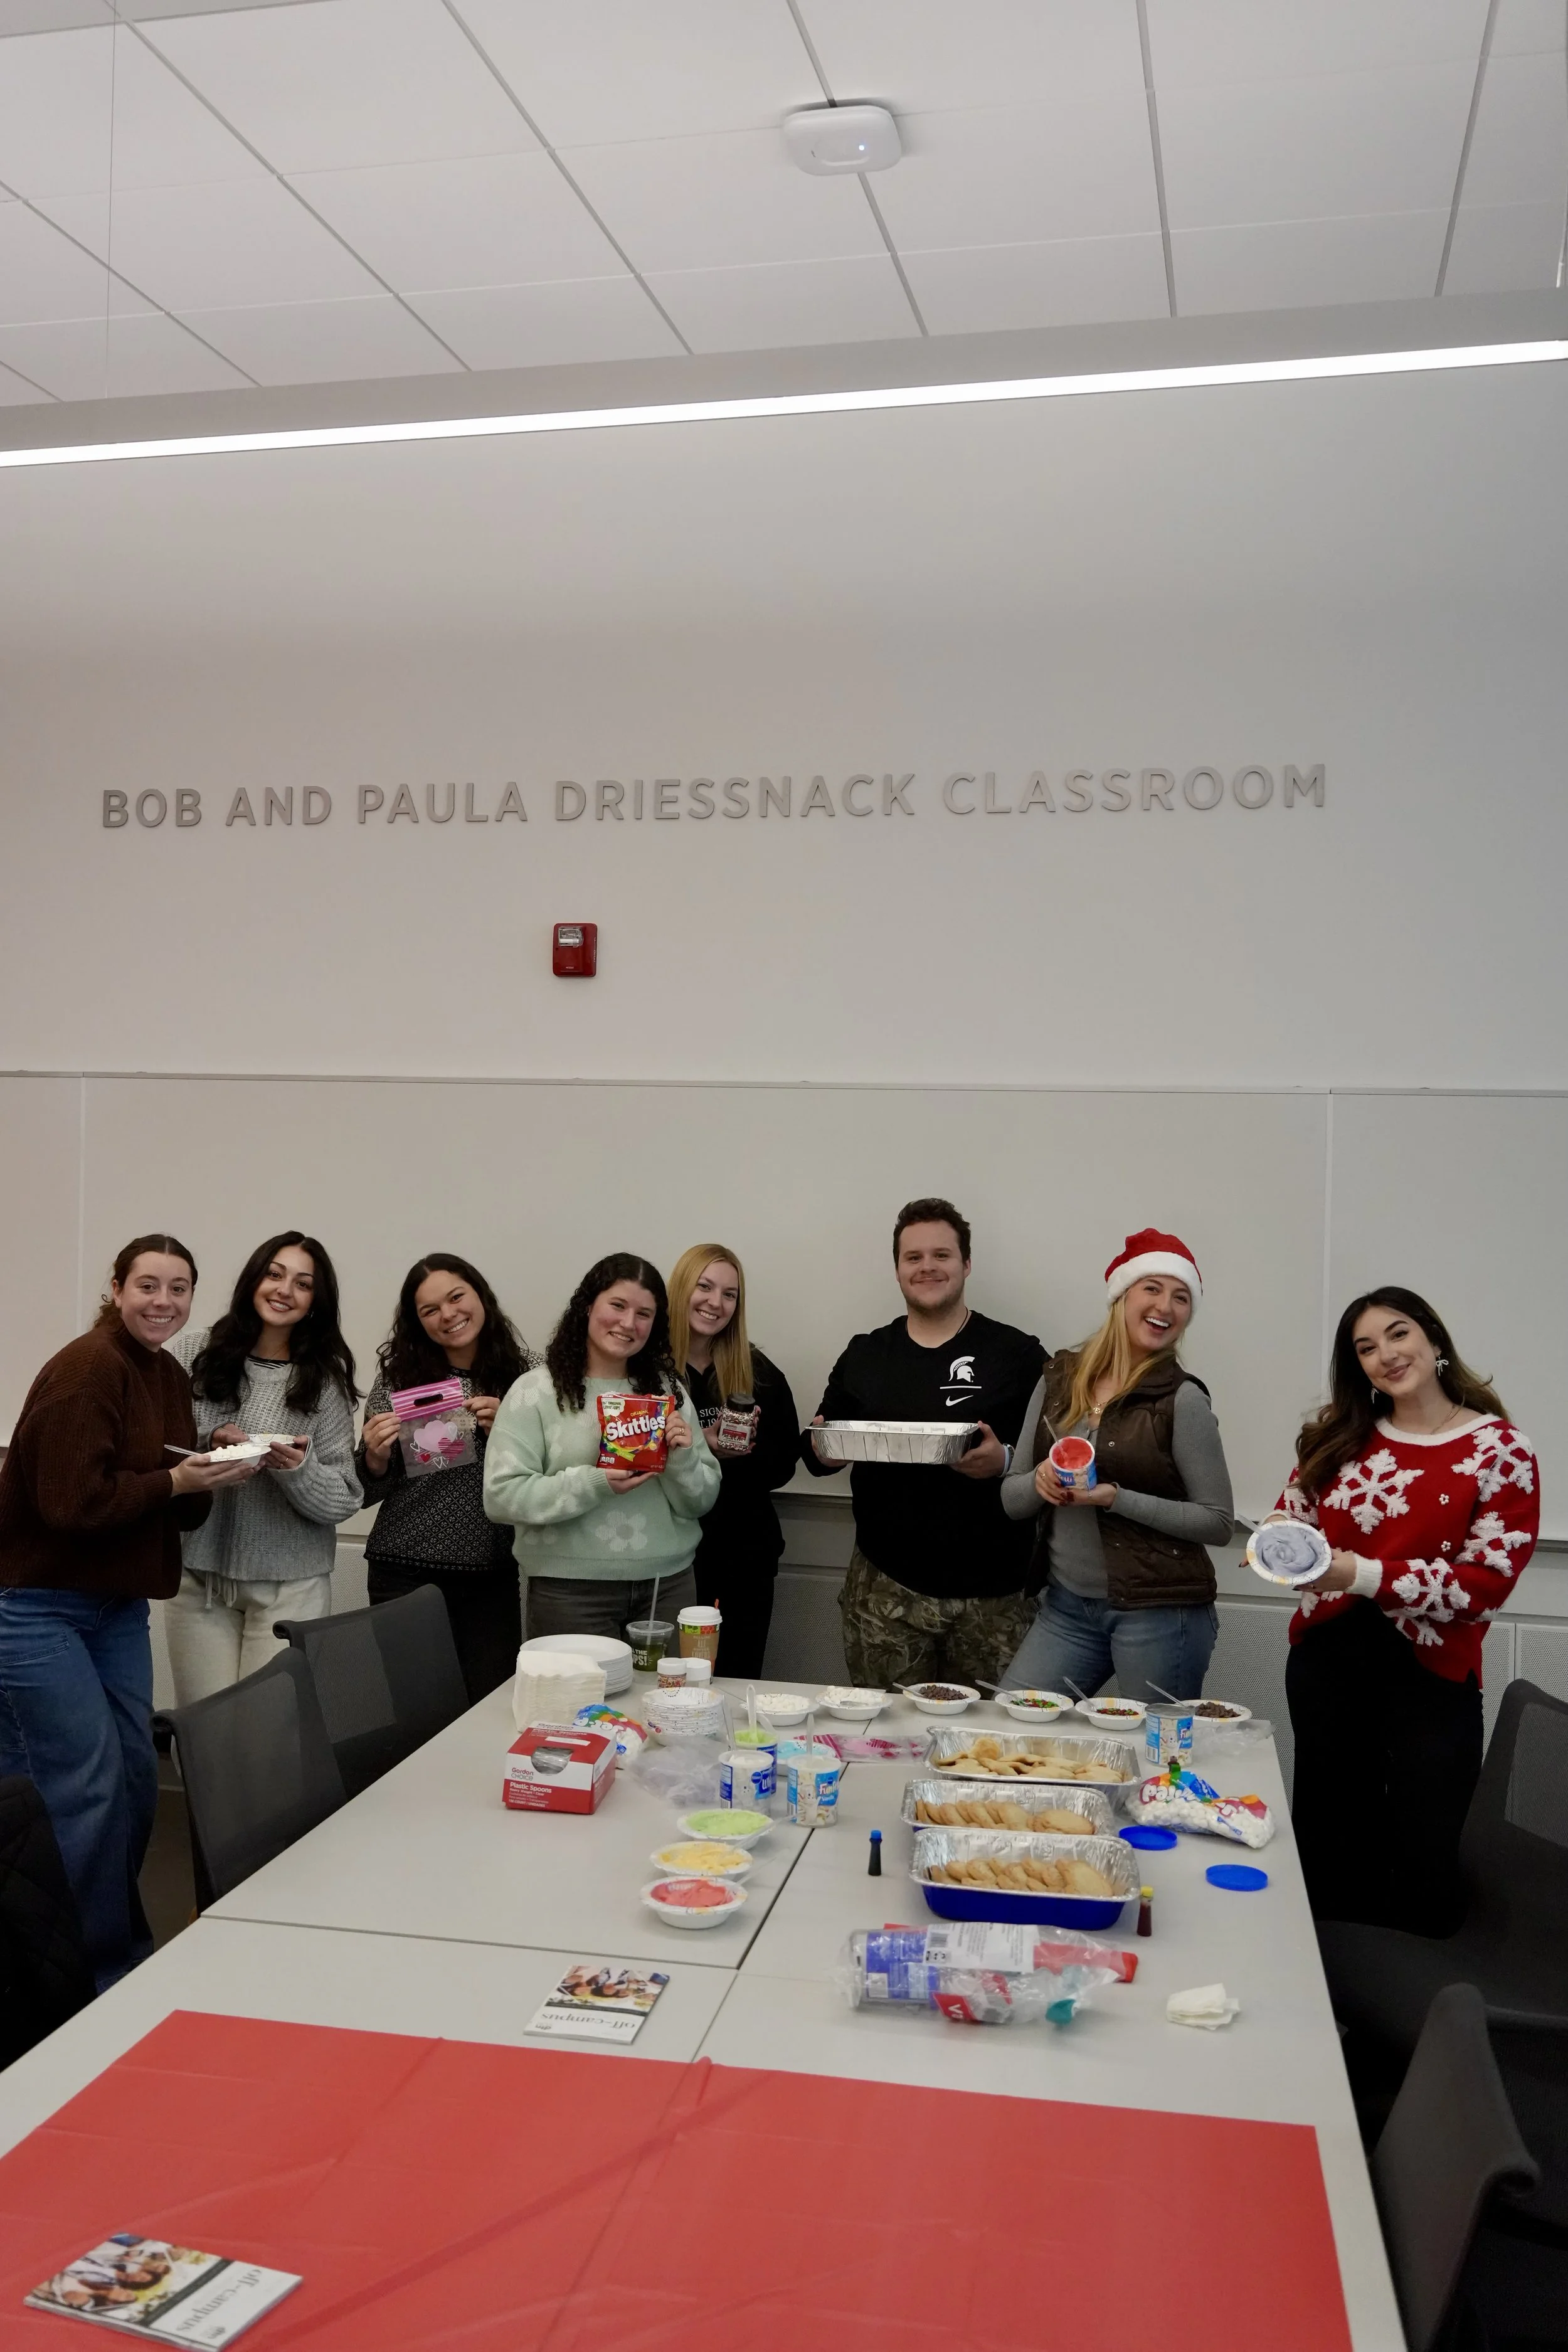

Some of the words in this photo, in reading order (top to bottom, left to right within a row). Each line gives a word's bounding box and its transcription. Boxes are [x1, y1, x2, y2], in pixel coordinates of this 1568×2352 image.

[103, 788, 202, 828] BOB
[226, 785, 332, 826] AND
[358, 781, 528, 824] PAULA
[555, 773, 915, 821] DRIESSNACK
[943, 763, 1325, 814] CLASSROOM
[606, 1415, 665, 1441] Skittles
[512, 1767, 533, 1776] Gordon
[530, 1785, 552, 1793] Spoons
[541, 2013, 635, 2029] off-campus
[176, 2269, 262, 2332] off-campus
